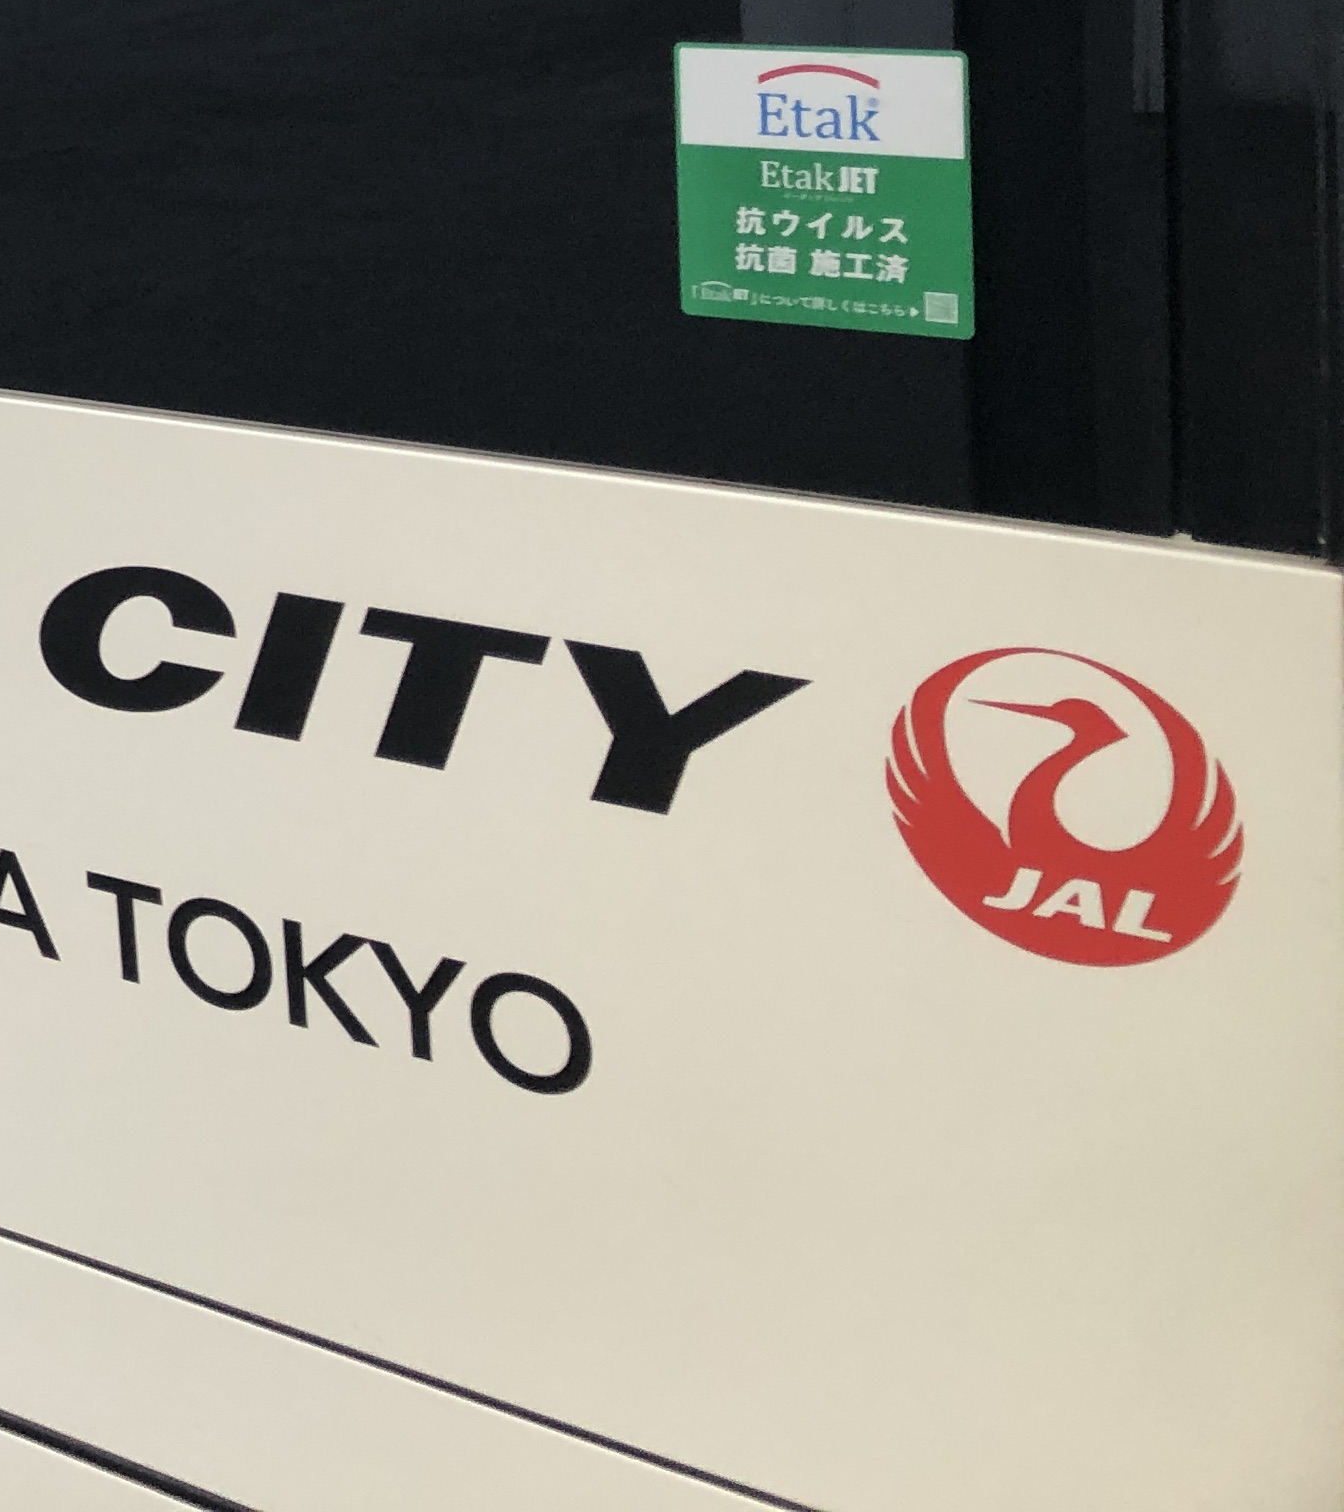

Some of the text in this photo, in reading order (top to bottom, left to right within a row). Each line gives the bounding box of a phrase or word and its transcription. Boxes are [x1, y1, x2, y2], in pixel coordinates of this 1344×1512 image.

[757, 92, 881, 142] Etak
[735, 206, 910, 244] 抗ウイルス
[735, 242, 911, 285] 抗菌 施工済
[40, 567, 811, 814] CITY
[982, 868, 1175, 944] JAL
[87, 871, 591, 1094] TOKYO
